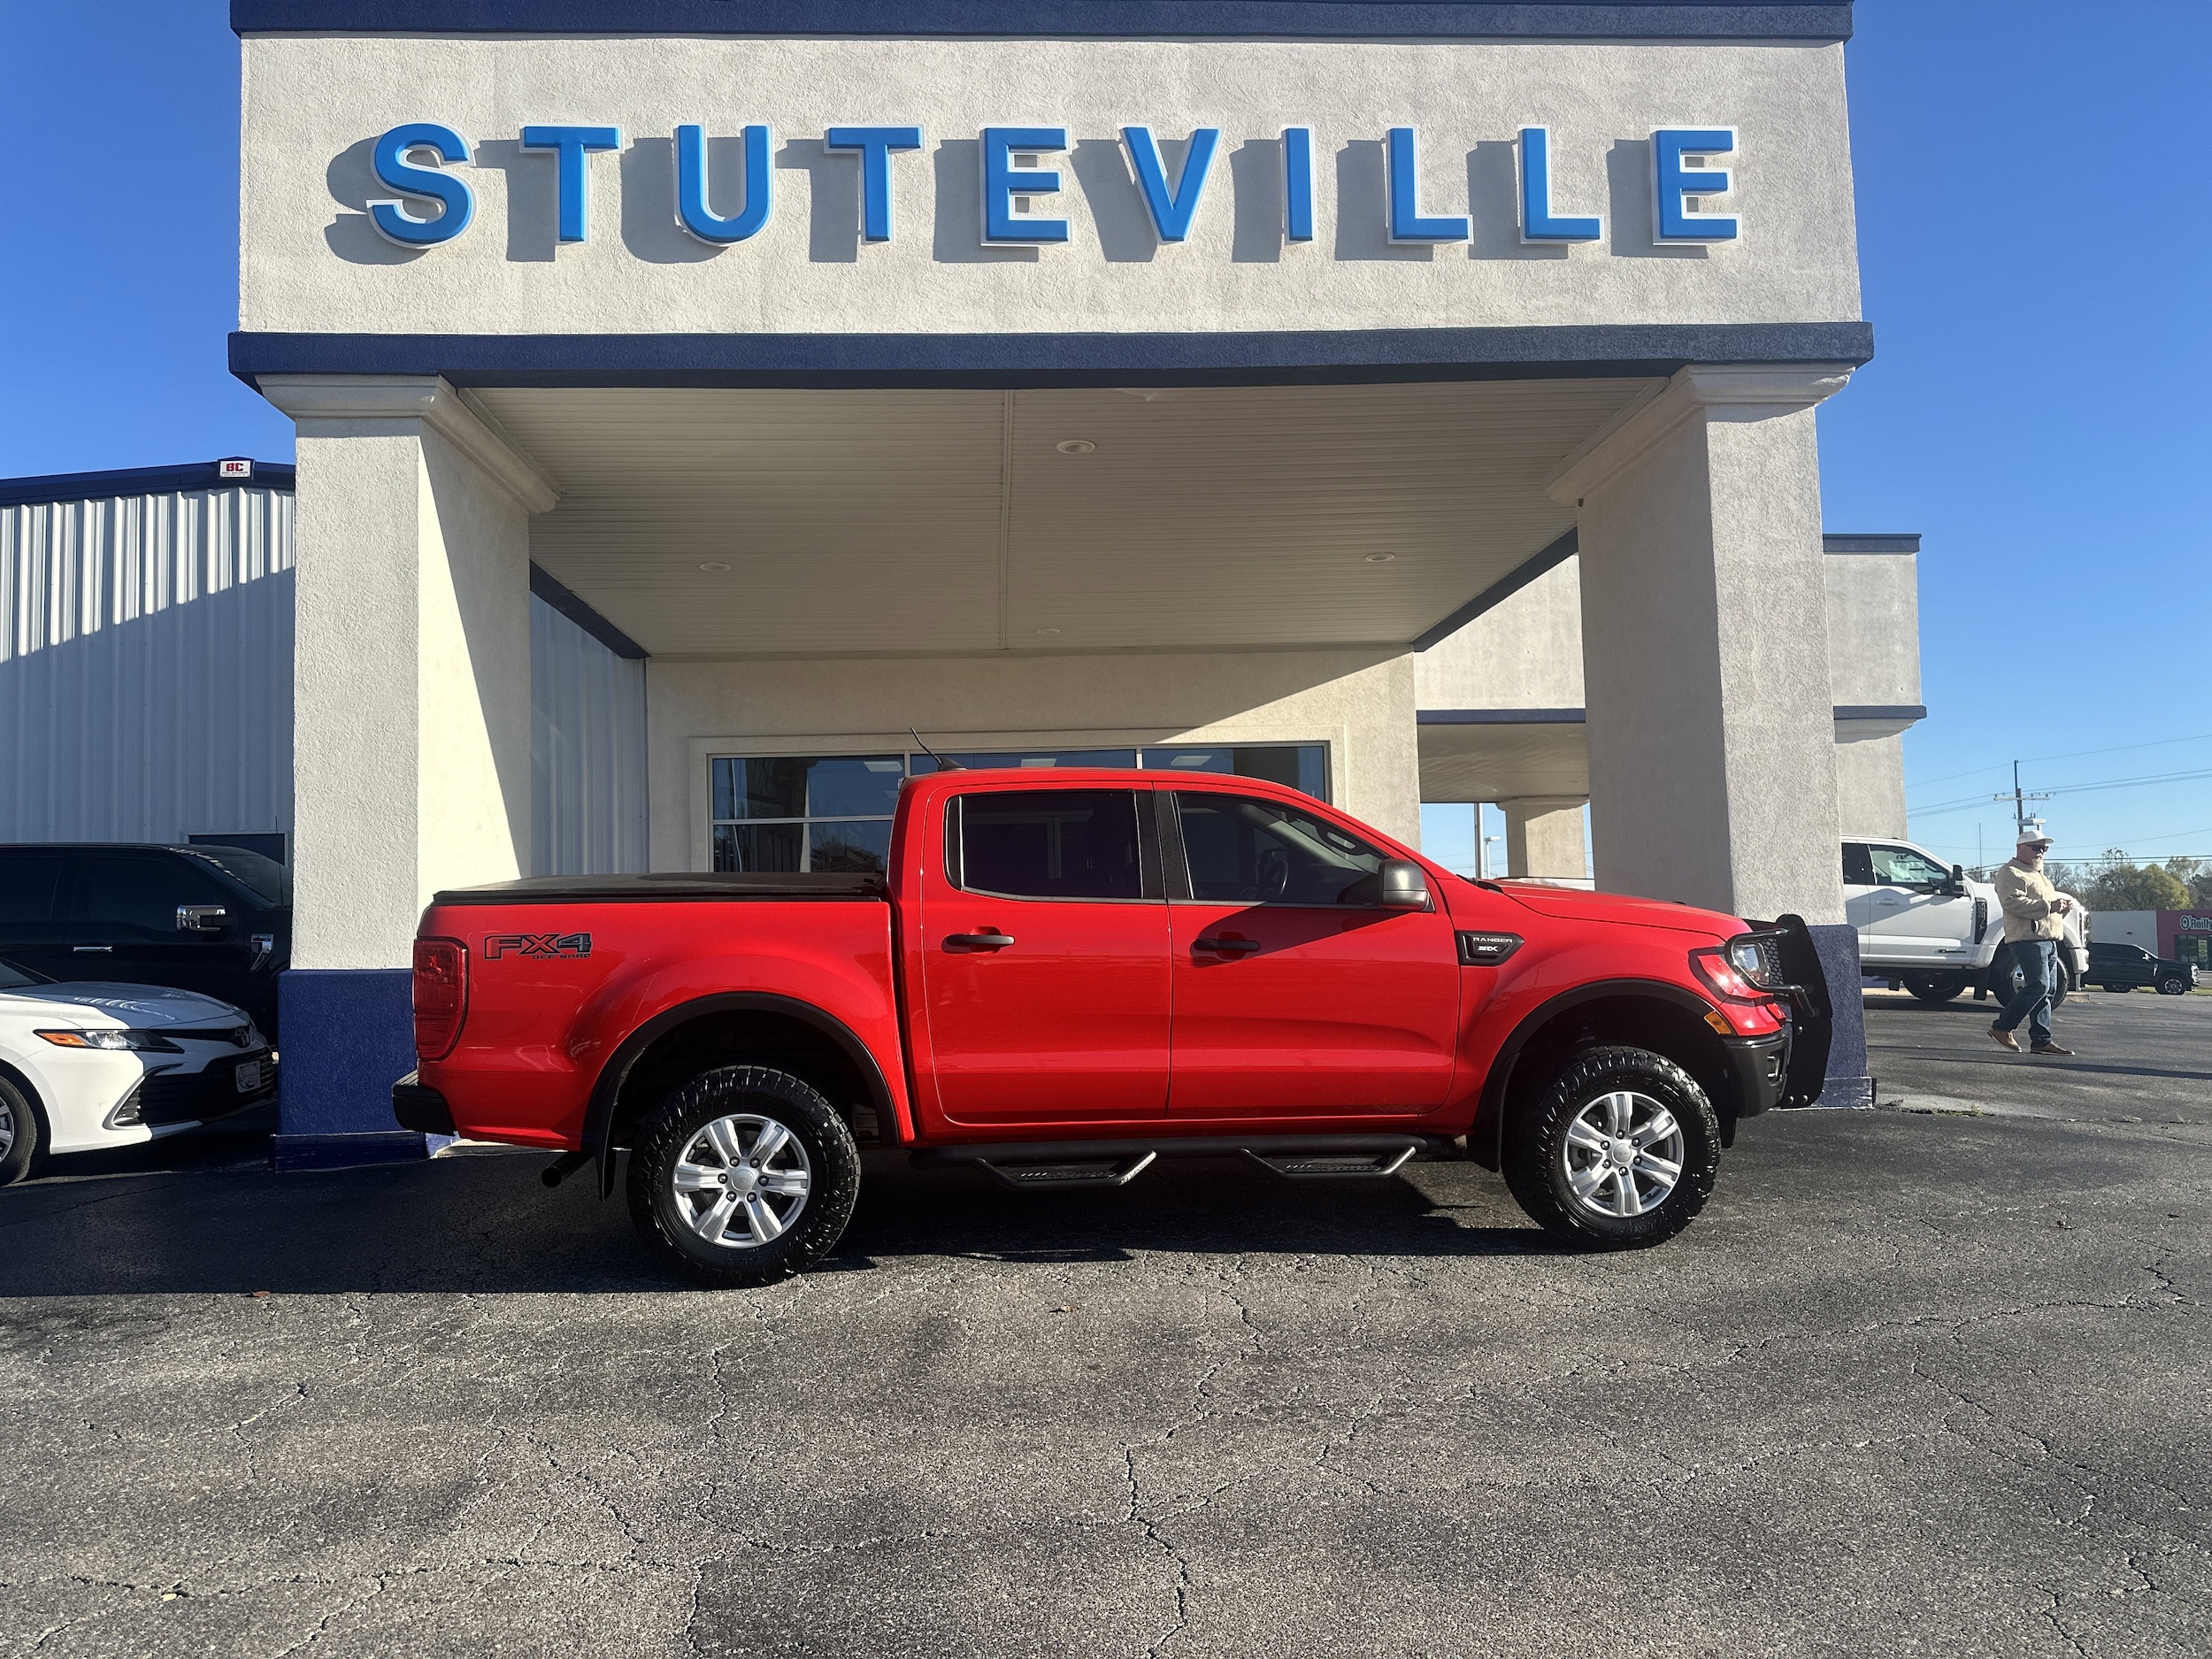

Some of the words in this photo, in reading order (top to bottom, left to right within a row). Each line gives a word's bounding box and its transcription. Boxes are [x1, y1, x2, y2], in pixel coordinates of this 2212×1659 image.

[367, 122, 1741, 249] STUTEVILLE
[226, 463, 243, 472] BC
[483, 933, 593, 960] FX4
